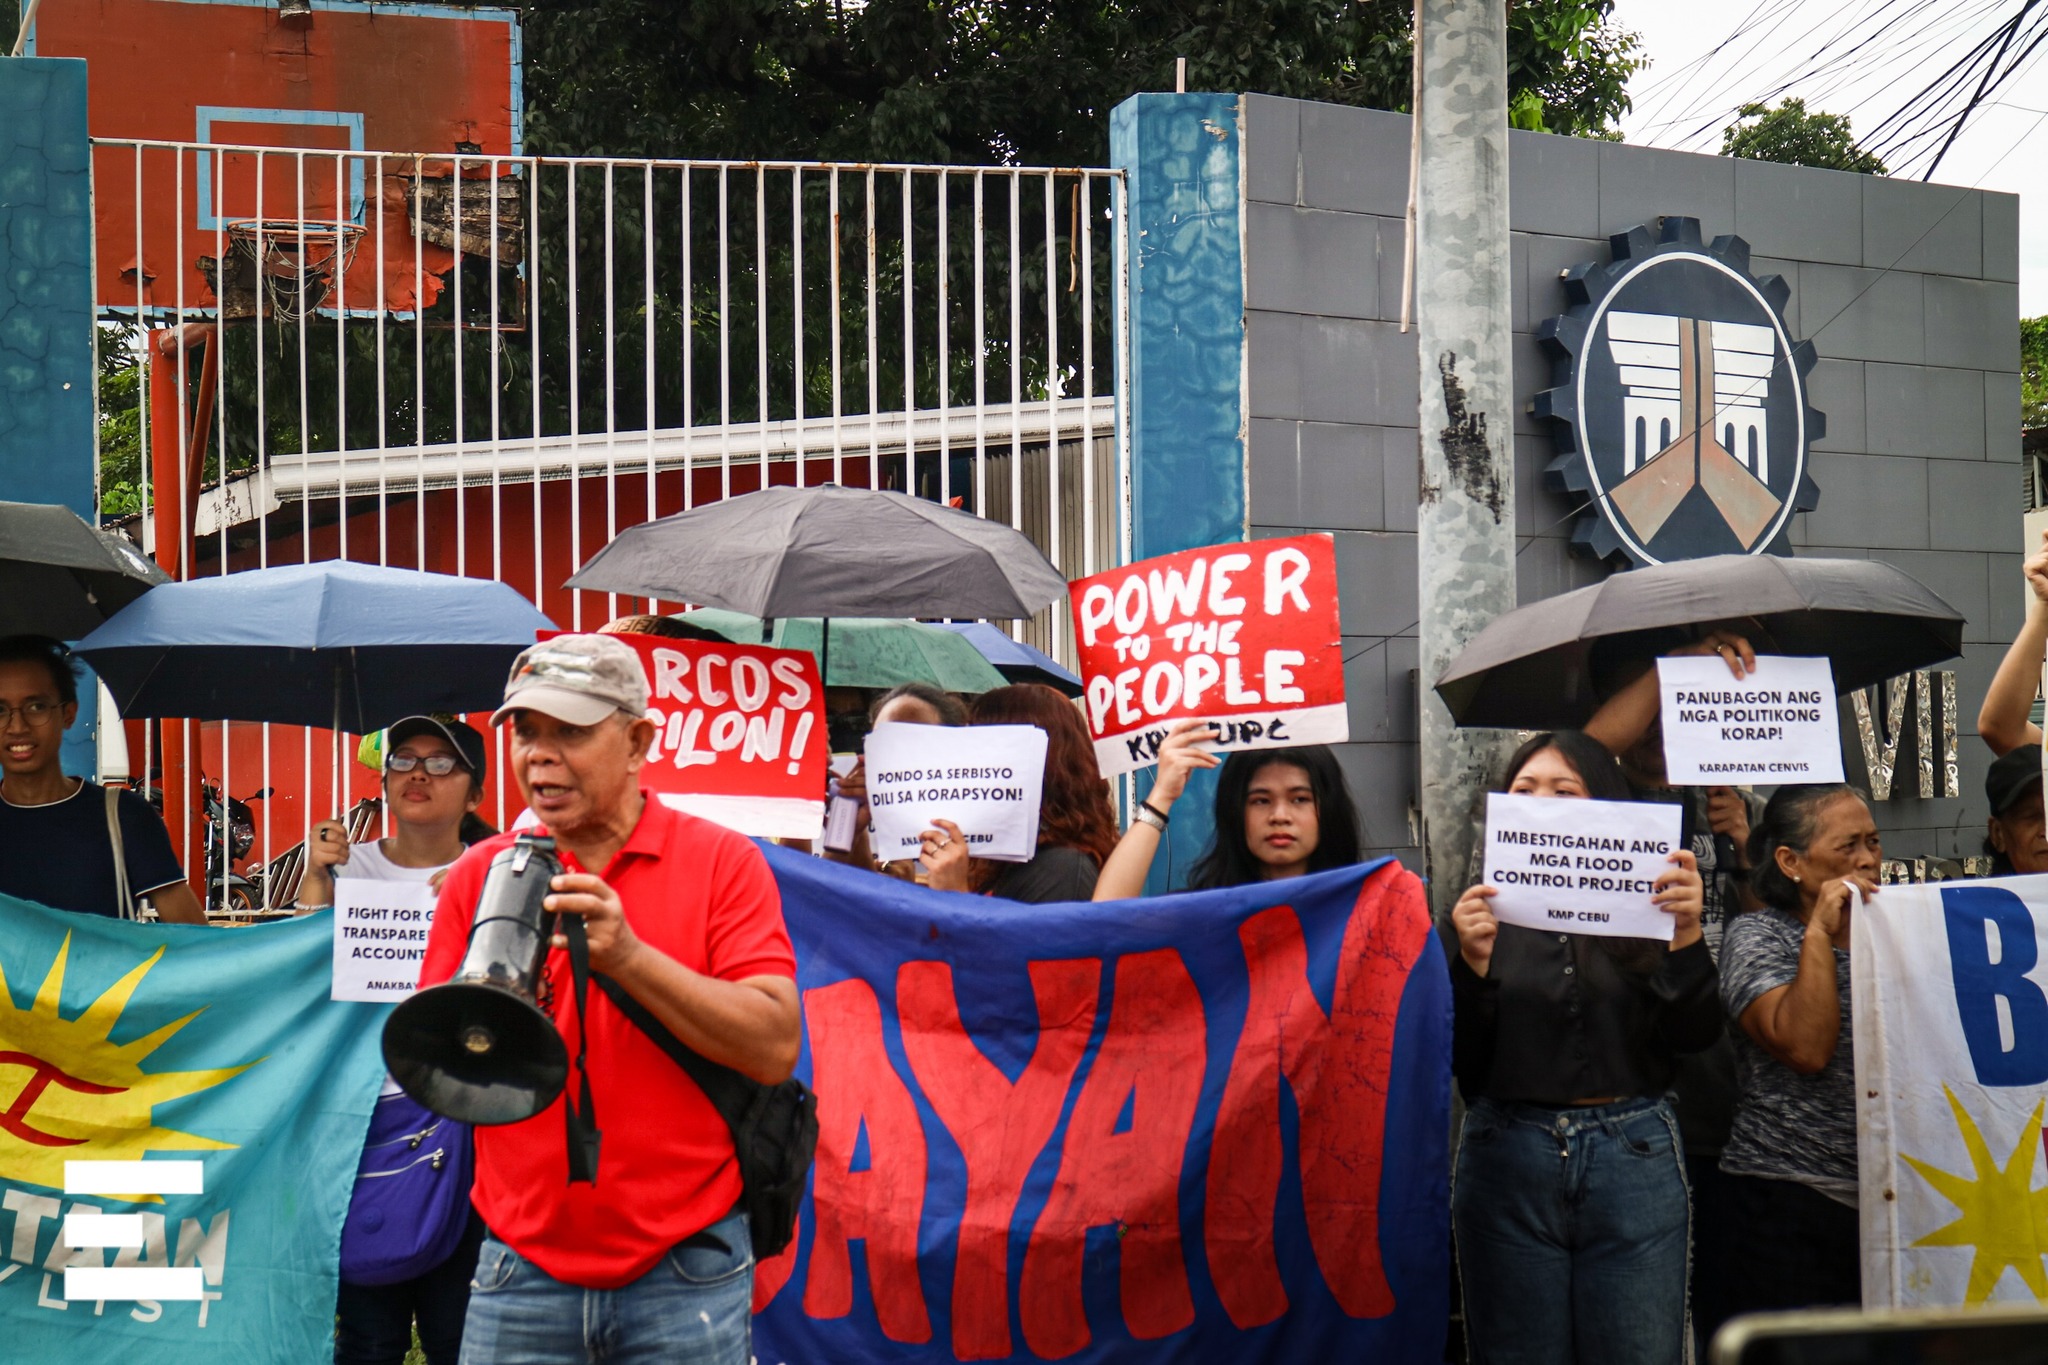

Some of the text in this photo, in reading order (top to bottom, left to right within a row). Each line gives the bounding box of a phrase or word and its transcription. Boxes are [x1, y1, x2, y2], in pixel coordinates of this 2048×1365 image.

[1080, 547, 1311, 646] POWER
[1113, 620, 1243, 663] TO THE
[1087, 650, 1305, 734] PEOPLE
[1676, 691, 1822, 705] PANUBAGON ANG
[1679, 708, 1821, 723] MGA POLITIKONG
[1721, 727, 1782, 741] KORAP!
[1851, 670, 1959, 800] VII
[878, 767, 1013, 784] PONDO SA SERBISYO
[1699, 762, 1809, 773] KARAPATAN CENVIS
[872, 787, 1023, 807] DILI SA KORAPSYON!
[1497, 830, 1669, 854] IMBESTIGAHAN ANG
[1529, 853, 1634, 873] MGA FLOOD
[1493, 870, 1574, 889] CONTROL
[348, 907, 389, 920] FIGHT
[392, 909, 421, 922] FOR
[1547, 908, 1610, 923] KMP CEBU
[343, 927, 431, 941] TRANSPARE
[755, 860, 1431, 1362] AYAN
